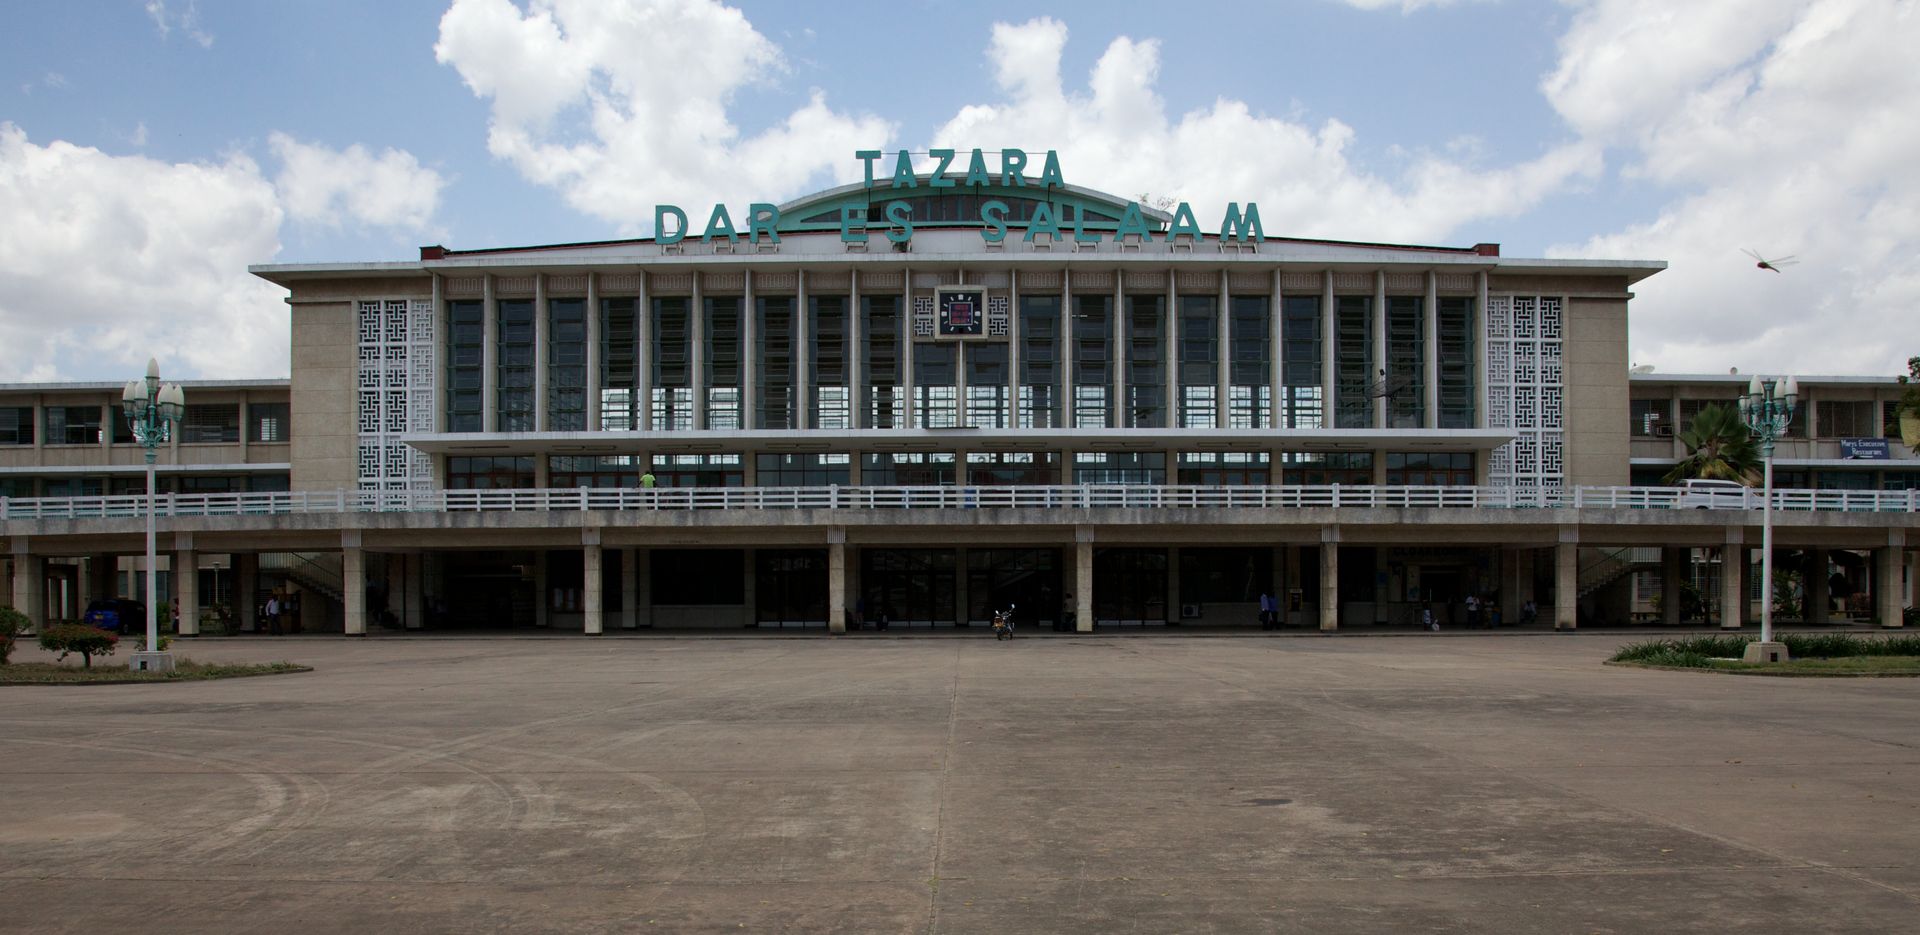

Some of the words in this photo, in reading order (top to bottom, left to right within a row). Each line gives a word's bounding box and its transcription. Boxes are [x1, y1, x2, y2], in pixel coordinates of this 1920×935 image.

[856, 148, 1064, 188] TAZARA
[655, 203, 782, 245] DAR
[841, 200, 914, 243] ES
[980, 200, 1265, 243] SALAAM
